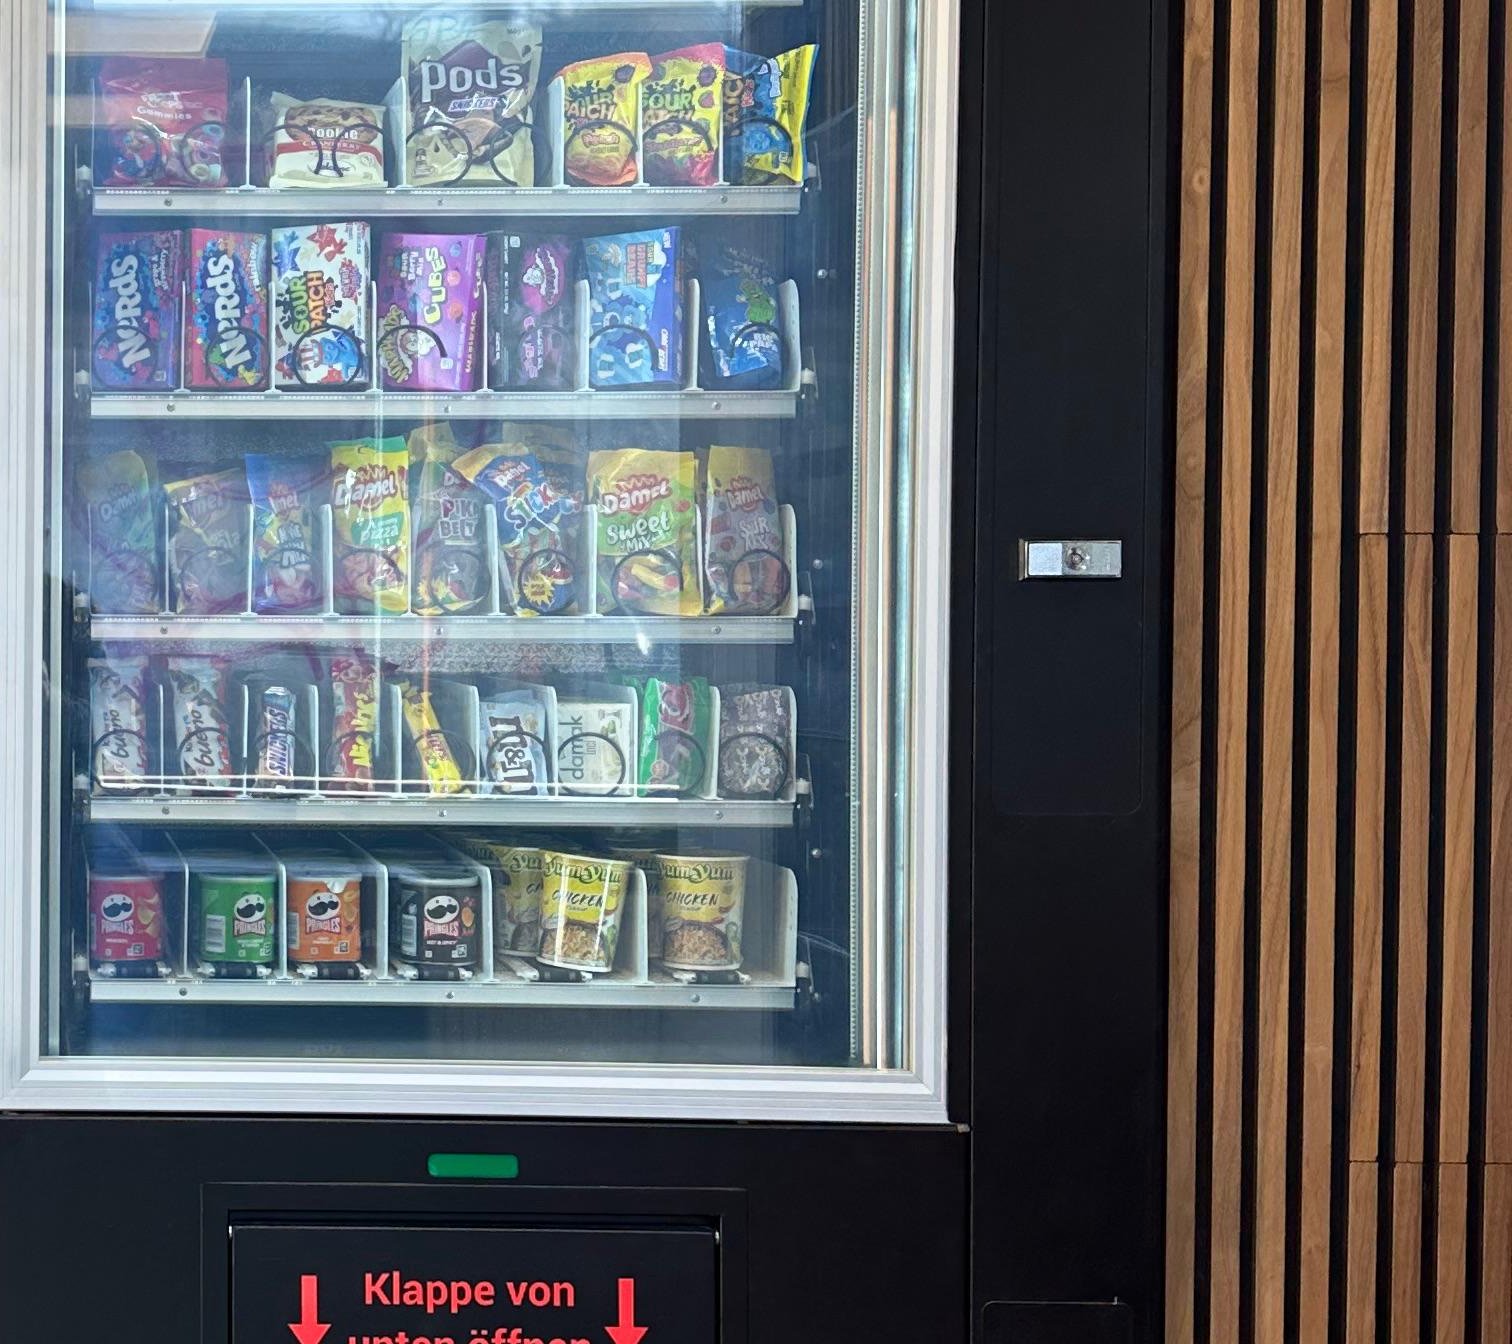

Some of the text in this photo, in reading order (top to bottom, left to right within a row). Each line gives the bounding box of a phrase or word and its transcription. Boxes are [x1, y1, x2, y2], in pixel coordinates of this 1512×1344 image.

[420, 57, 524, 103] pods
[136, 105, 193, 120] Gummies
[290, 276, 309, 335] SOUR
[306, 271, 326, 334] PATCH
[424, 246, 447, 324] CUBES
[606, 512, 671, 545] Sweet
[559, 715, 584, 781] damak
[665, 891, 720, 907] CHICKEN
[364, 1270, 575, 1314] Klappe von
